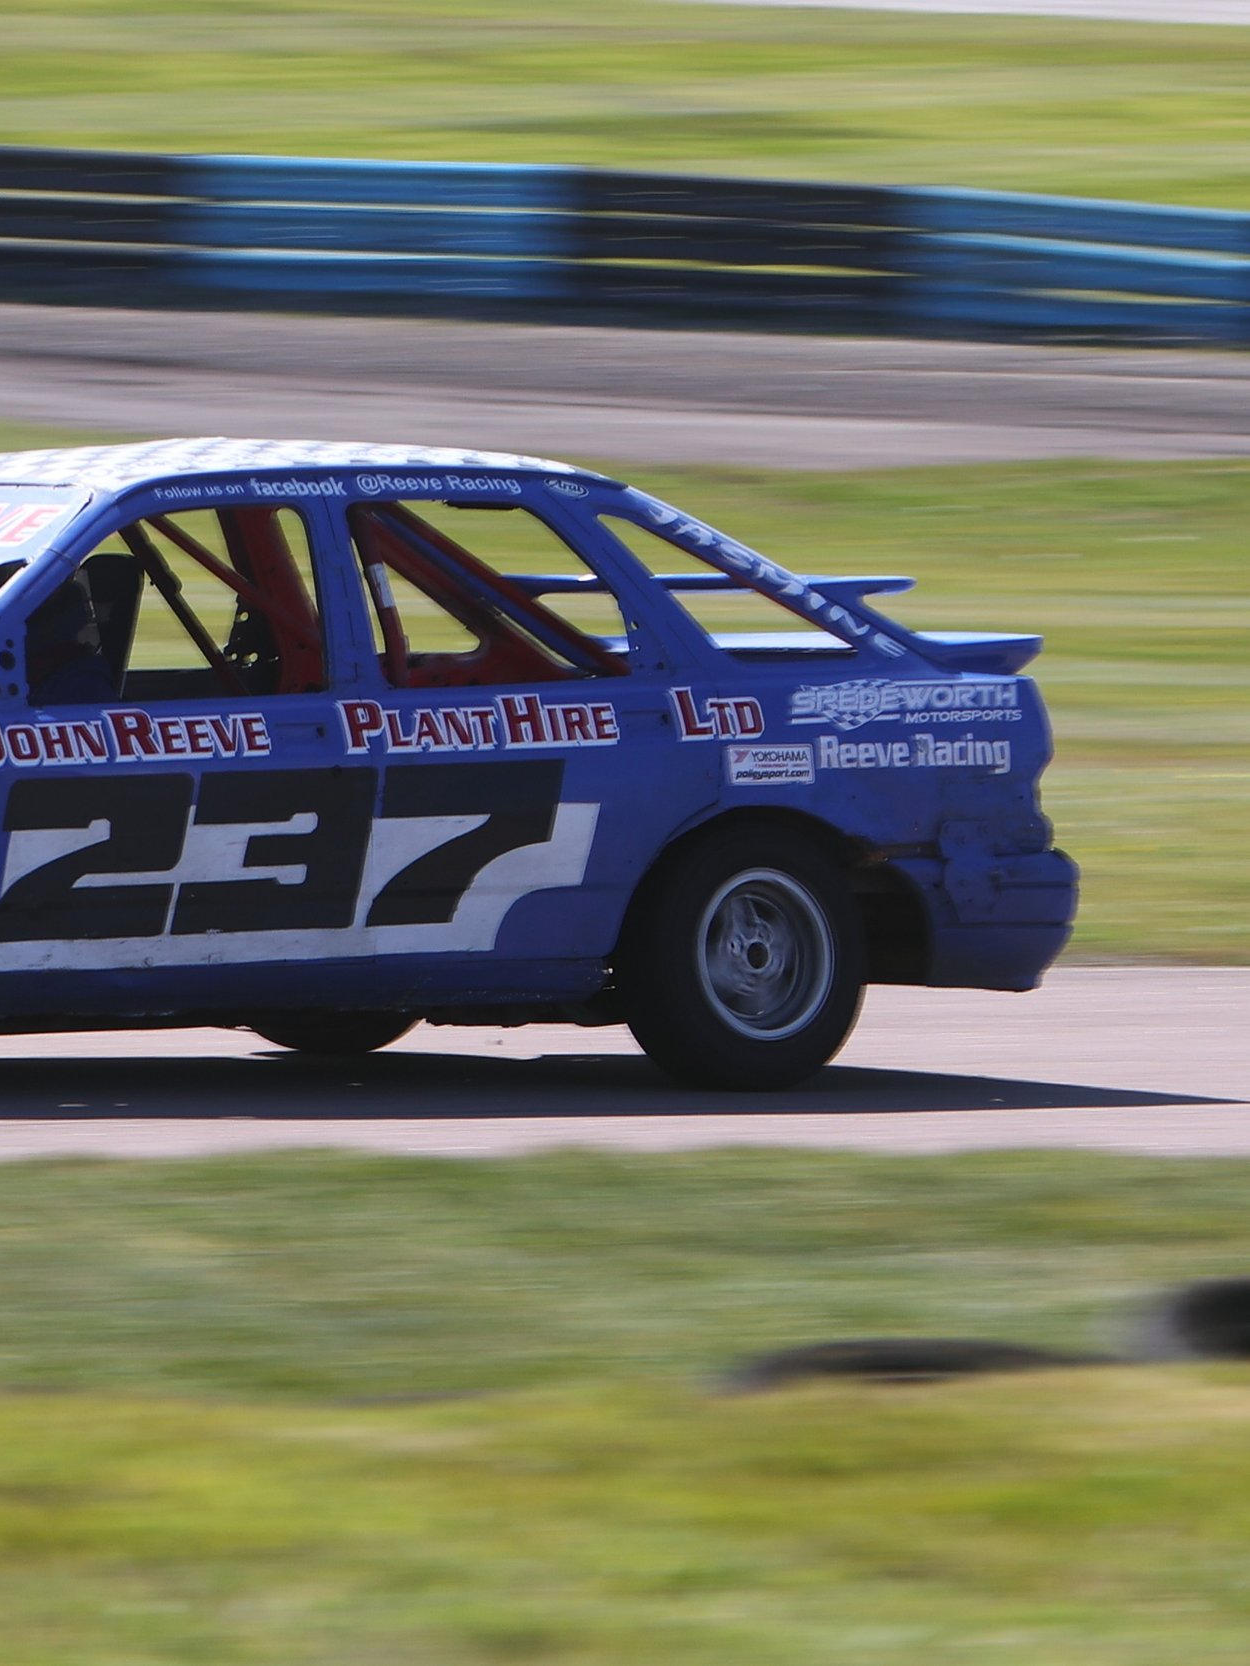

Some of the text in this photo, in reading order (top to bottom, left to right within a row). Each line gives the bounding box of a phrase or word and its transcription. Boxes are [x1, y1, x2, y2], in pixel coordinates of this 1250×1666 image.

[154, 477, 347, 500] Follow us on facebook
[356, 474, 522, 495] @Reeve Racing
[336, 699, 496, 754] PLANT
[495, 693, 620, 750] HIRE
[904, 710, 1022, 724] MOTORSPORTS
[751, 750, 809, 762] YOKOHAMA
[820, 733, 1011, 774] Reeve Racing
